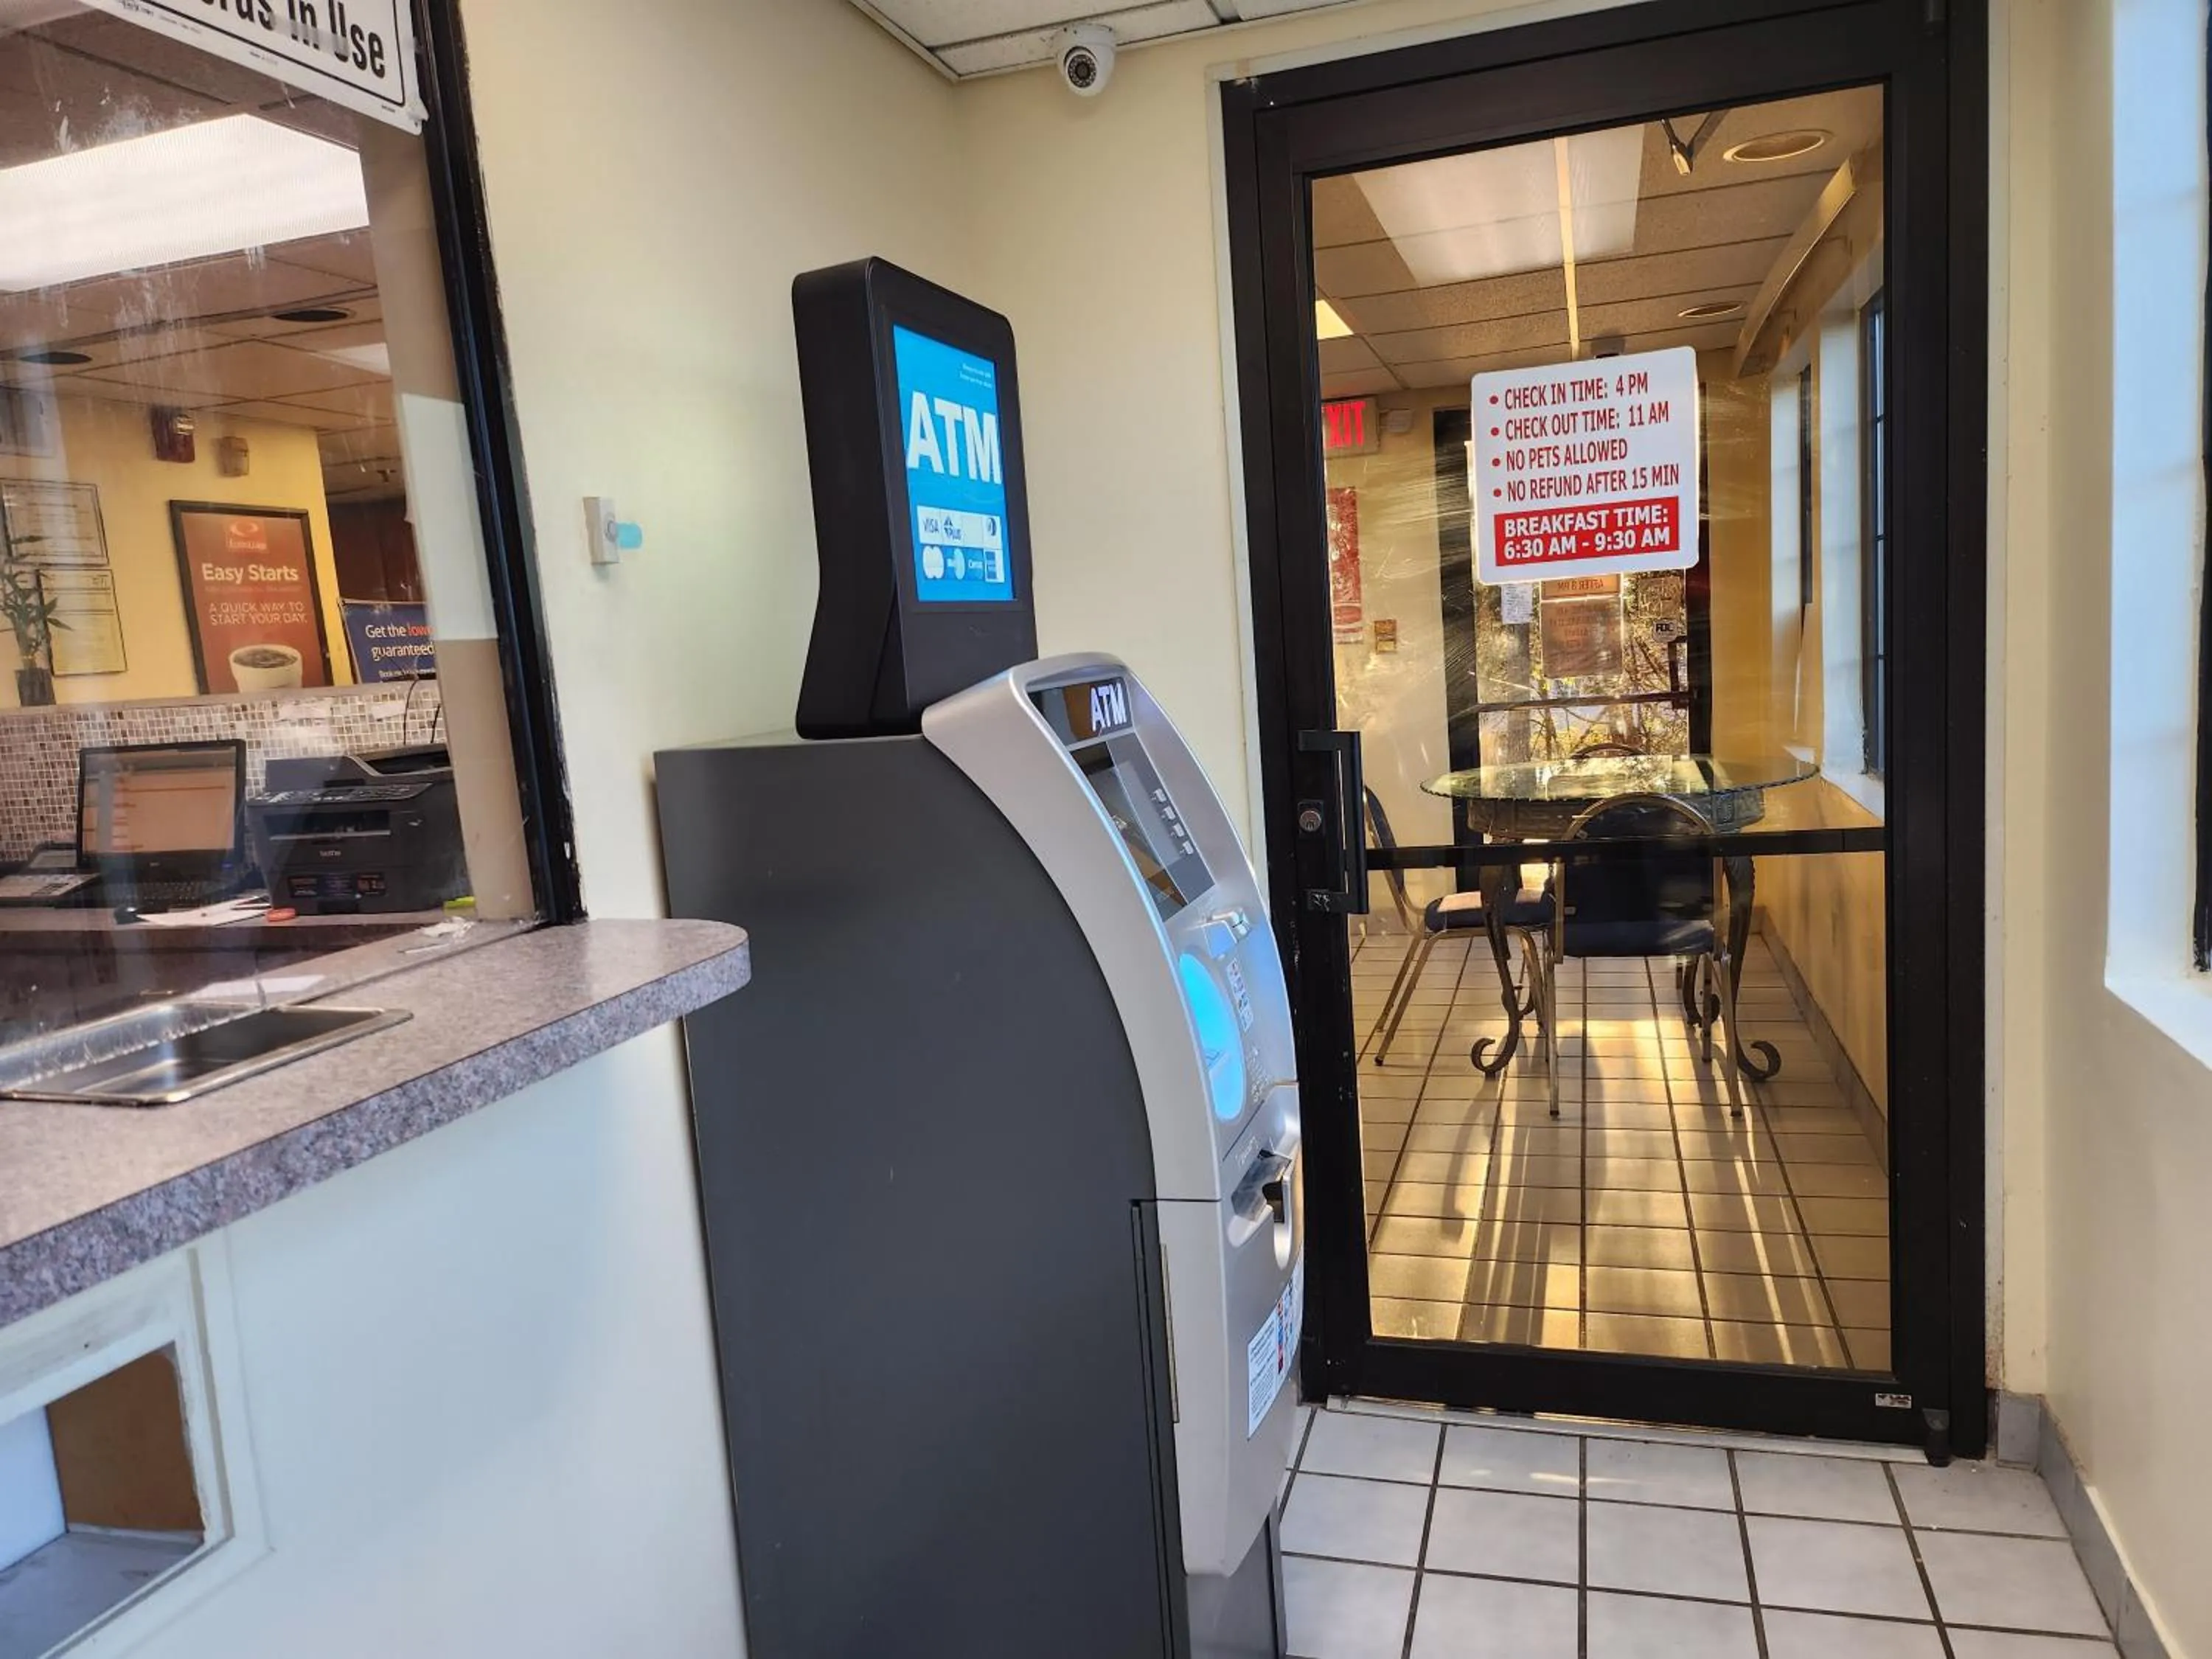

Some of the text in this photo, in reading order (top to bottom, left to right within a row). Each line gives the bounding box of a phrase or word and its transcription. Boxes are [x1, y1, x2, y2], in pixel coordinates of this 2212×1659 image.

[328, 0, 385, 78] Use
[1505, 372, 1648, 410] CHECK IN TIME: 4 PM
[907, 390, 1001, 484] ATM
[1323, 401, 1366, 448] XIT
[1506, 400, 1669, 441] CHECK OUT TIME: 11 AM
[1506, 438, 1628, 472] NO PETS ALLOWED
[1507, 463, 1679, 501] NO REFUND AFTER 15 MIN
[923, 518, 939, 533] VISA
[1505, 504, 1669, 538] BREAKFAST TIME:
[1504, 539, 1543, 560] 6:30
[1548, 535, 1576, 554] AM
[1595, 530, 1635, 552] 9:30
[1641, 526, 1669, 547] AM
[202, 563, 299, 584] Easy Starts
[209, 601, 305, 613] A QUICK WAY TO
[211, 613, 246, 625] START
[251, 613, 282, 624] YOUR
[365, 625, 386, 638] Get
[387, 622, 406, 636] the
[371, 641, 435, 661] guaranteed
[1090, 683, 1127, 731] ATM
